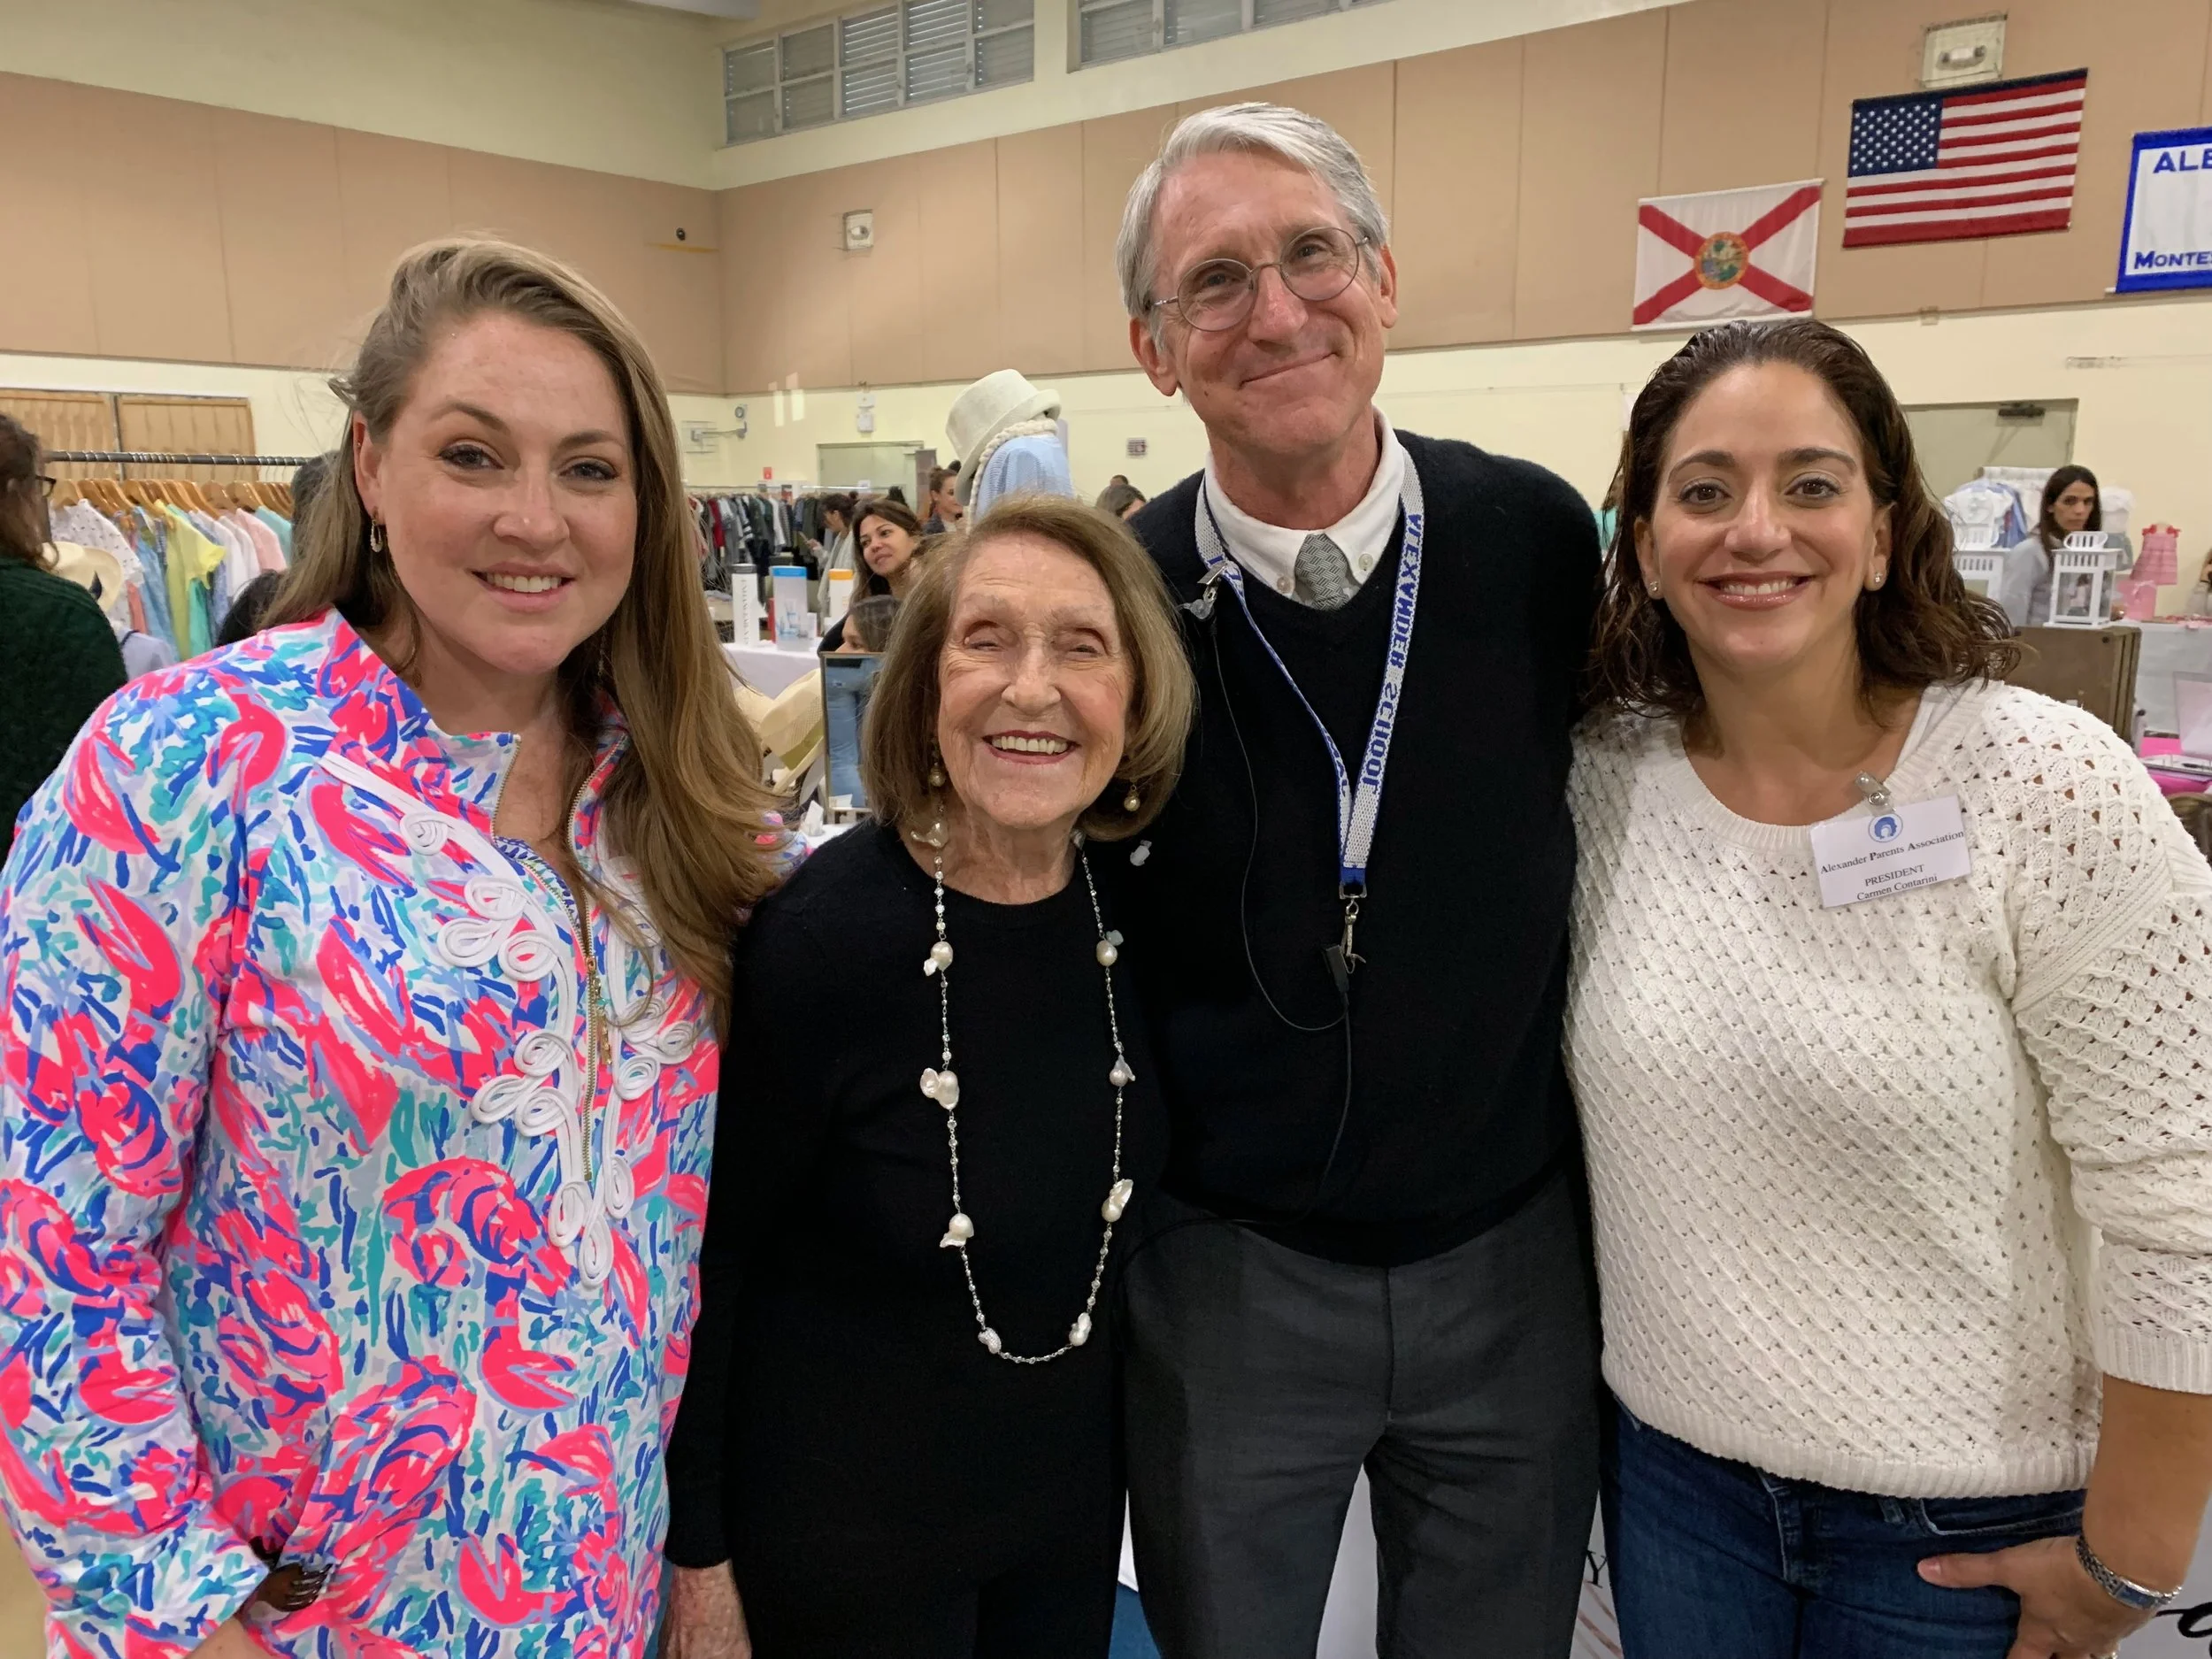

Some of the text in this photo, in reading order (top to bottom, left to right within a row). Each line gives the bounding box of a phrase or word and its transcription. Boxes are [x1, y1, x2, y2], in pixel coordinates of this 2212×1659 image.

[2134, 250, 2212, 269] MONTE
[1820, 831, 1964, 874] Alexander Parents Association
[1864, 864, 1925, 887] PRESIDENT
[1856, 875, 1938, 901] Carmen Contarini
